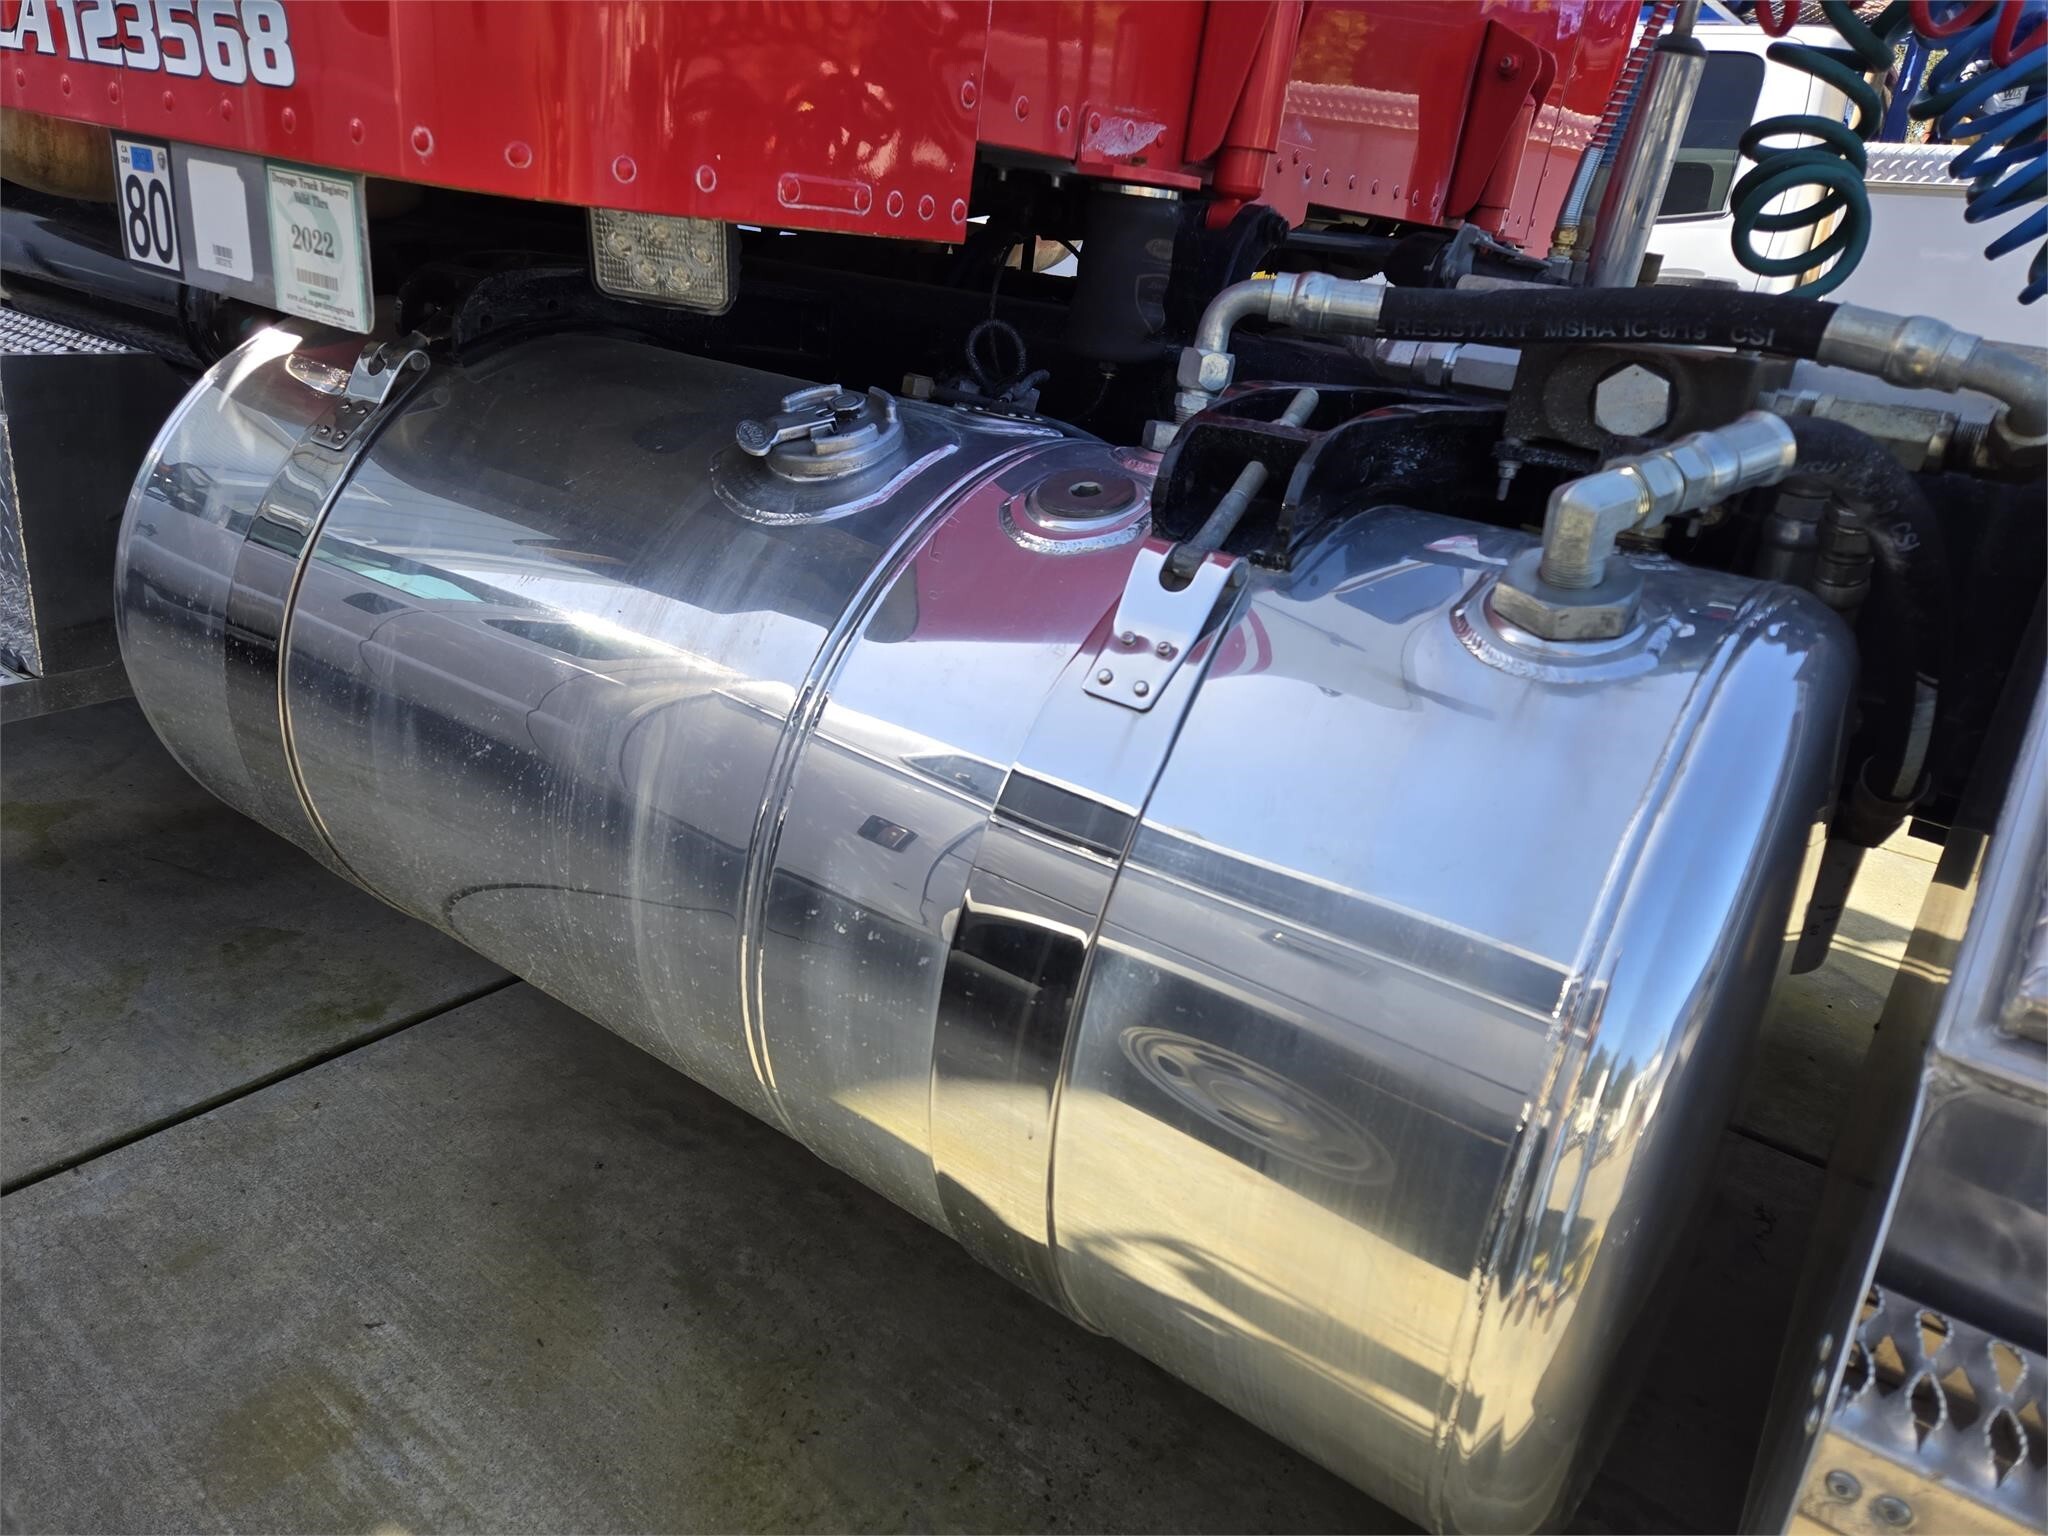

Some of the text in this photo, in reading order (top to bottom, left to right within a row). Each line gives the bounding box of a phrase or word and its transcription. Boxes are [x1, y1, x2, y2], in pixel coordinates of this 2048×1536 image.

[299, 177, 319, 192] Truck
[321, 182, 349, 200] Registry
[125, 174, 174, 265] 80
[291, 223, 335, 259] 2022
[1393, 318, 1529, 338] RESISTANT
[1543, 317, 1617, 338] MSHA
[1729, 325, 1777, 347] CSI
